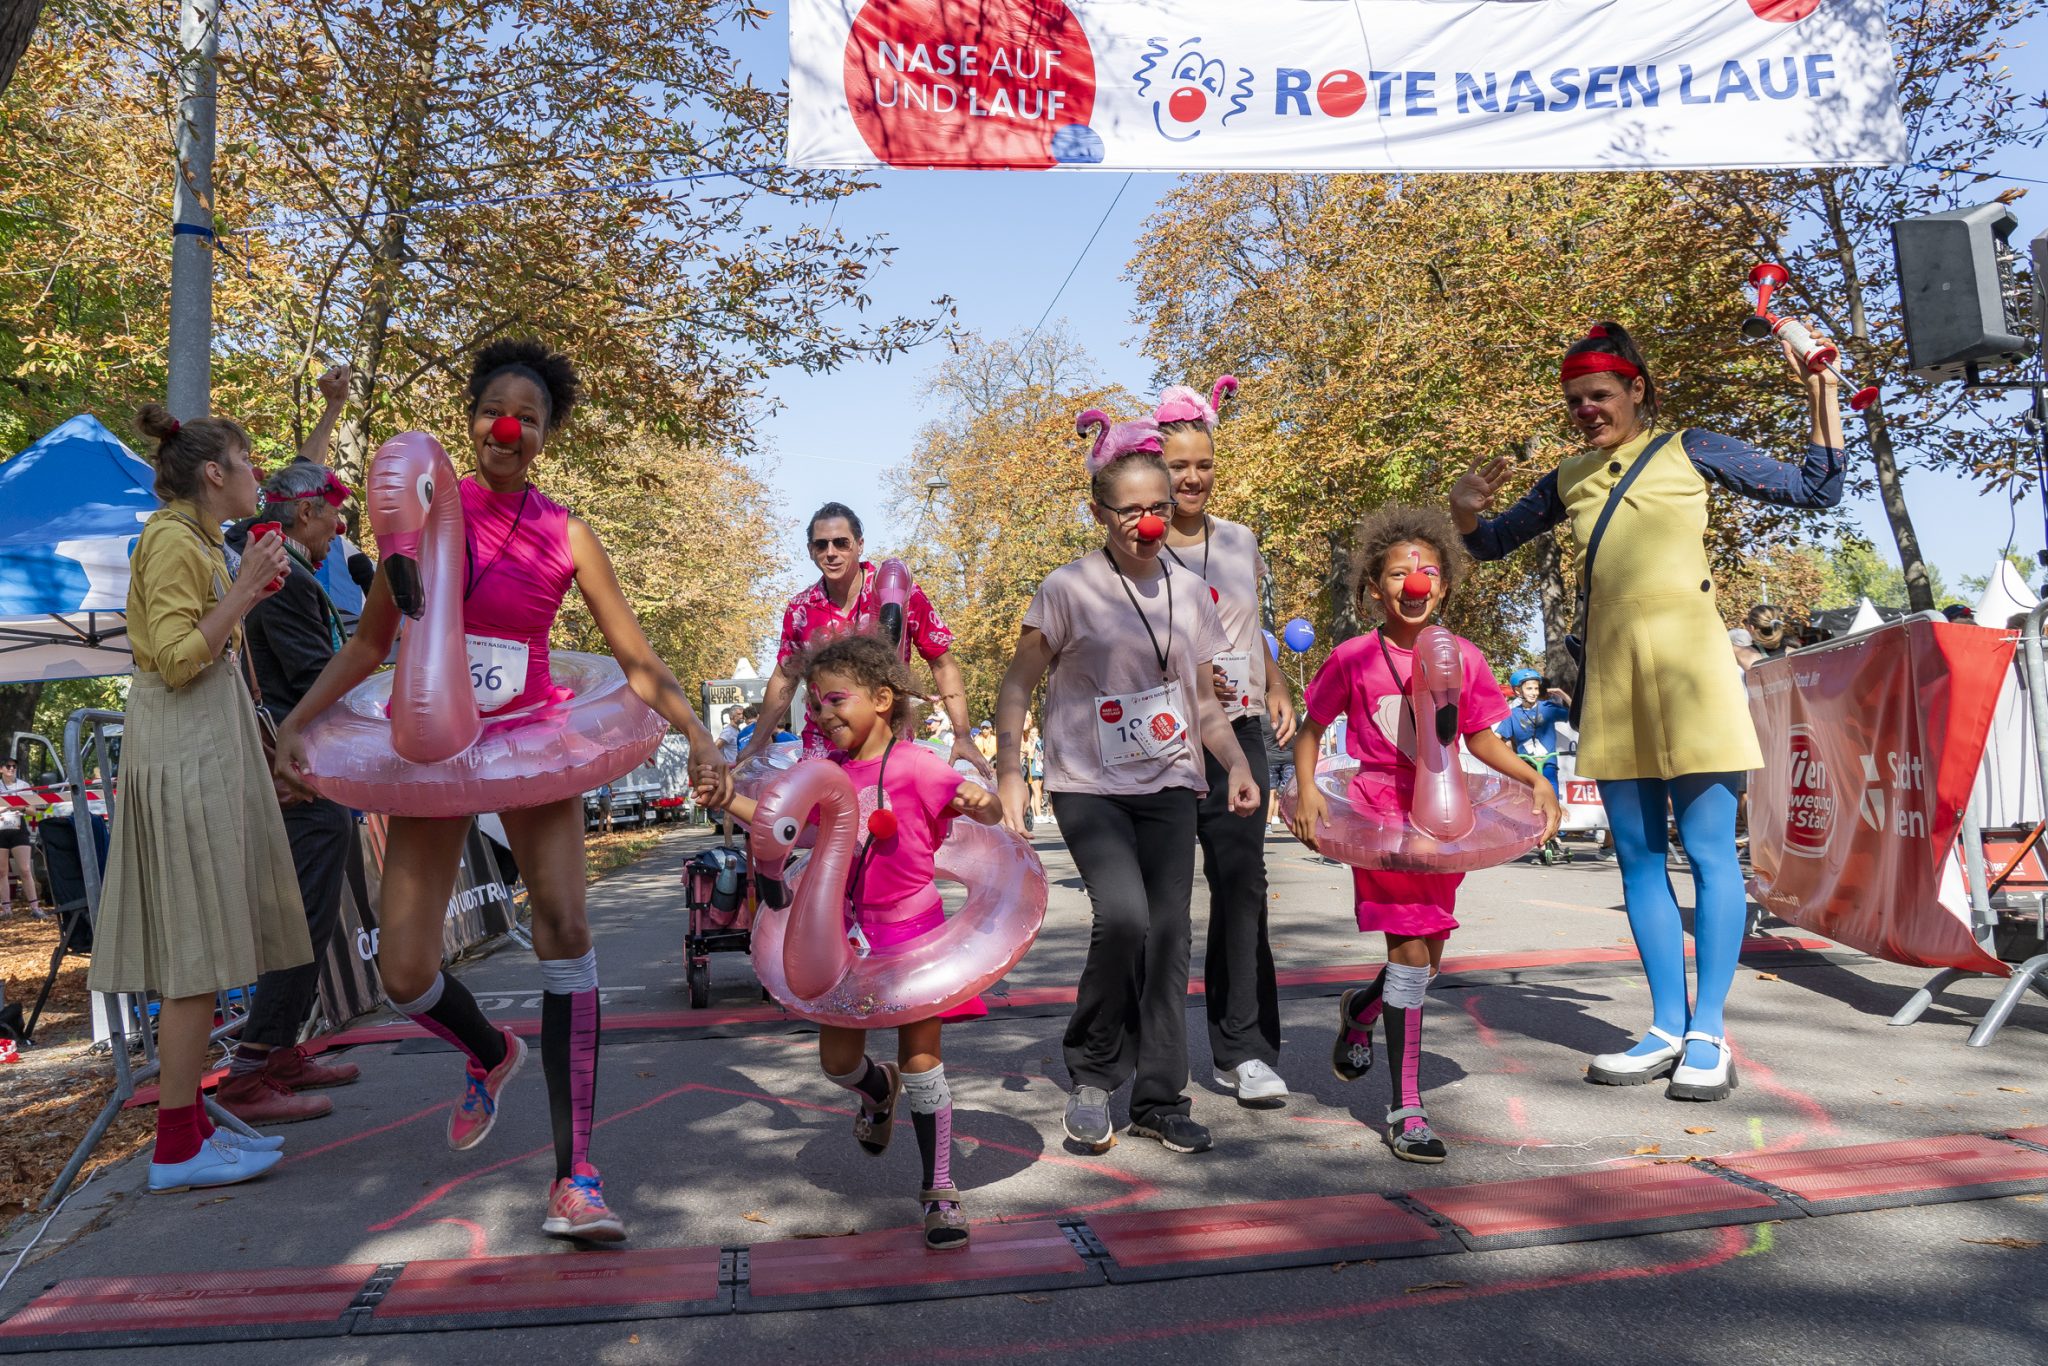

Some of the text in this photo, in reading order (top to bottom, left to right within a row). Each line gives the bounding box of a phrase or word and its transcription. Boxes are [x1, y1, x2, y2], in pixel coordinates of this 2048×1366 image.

[877, 40, 1062, 80] NASE AUF
[873, 77, 1066, 122] UND LAUF
[1455, 64, 1662, 115] NASEN
[1679, 53, 1835, 104] LAUF
[710, 687, 737, 696] WRAP
[1572, 784, 1602, 802] ZIEL
